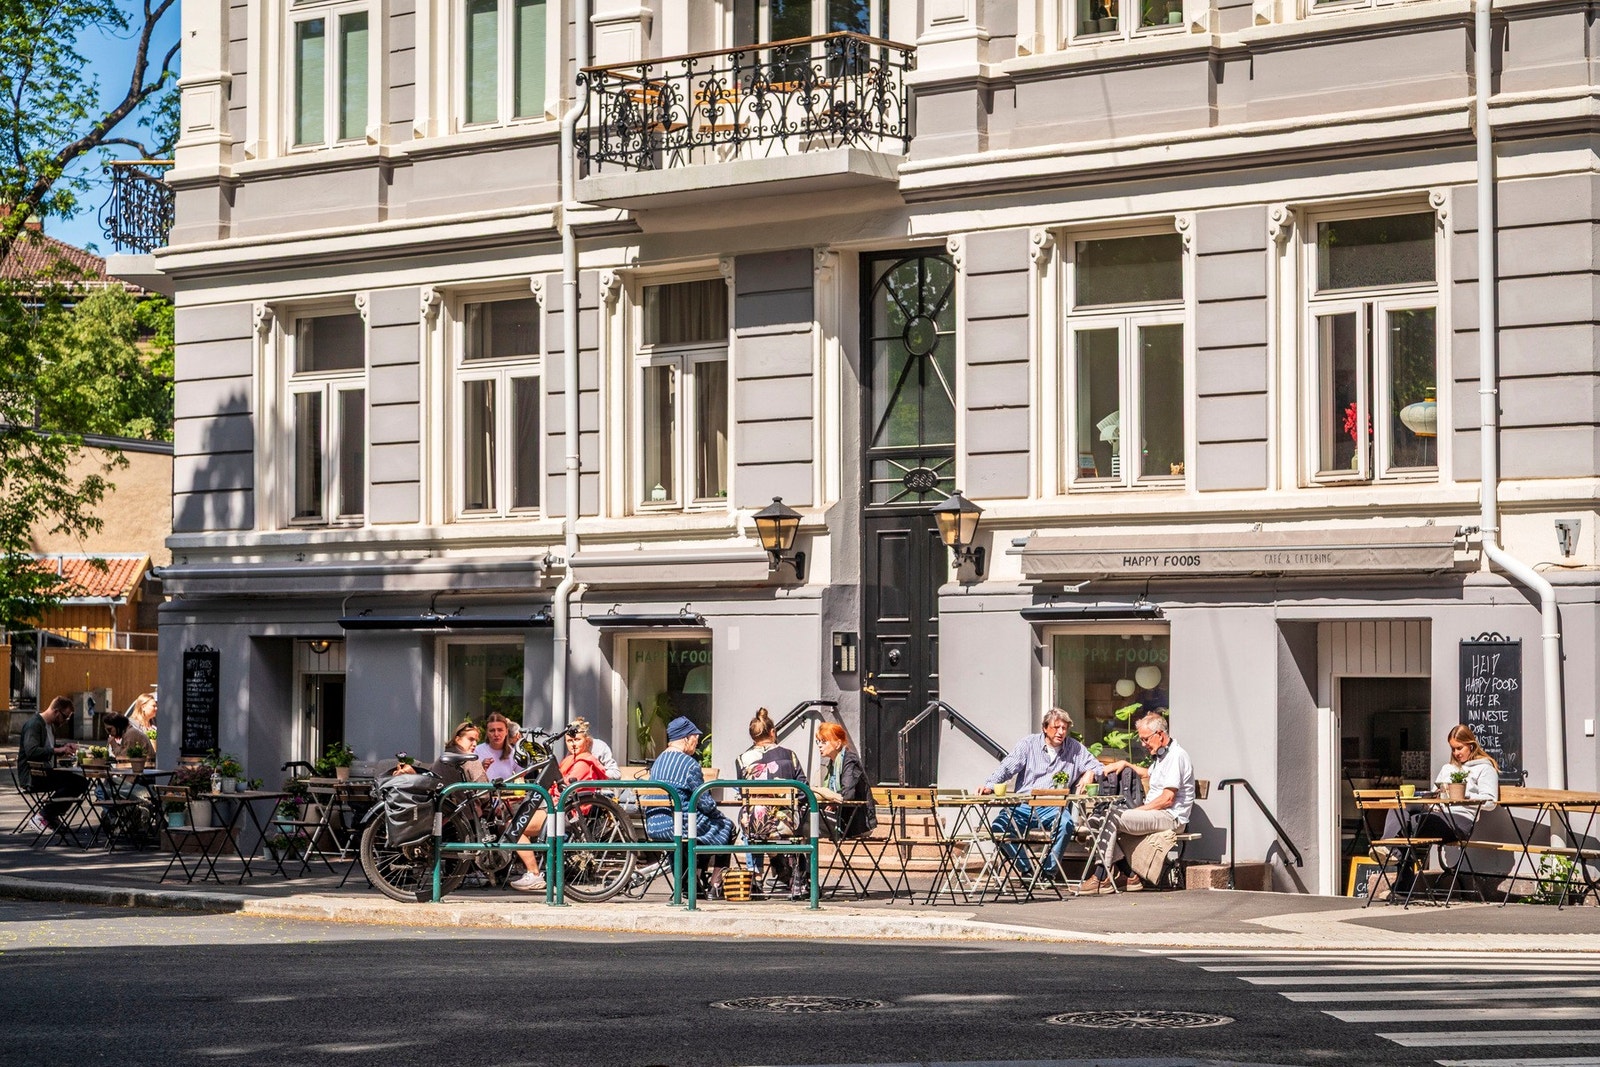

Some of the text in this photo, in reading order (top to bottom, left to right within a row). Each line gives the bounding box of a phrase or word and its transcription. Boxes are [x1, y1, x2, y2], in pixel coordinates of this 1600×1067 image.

[1122, 555, 1201, 567] HAPPY FOODS
[1264, 552, 1333, 565] CAFÉ & CATERING
[1116, 648, 1169, 663] FOODS
[1465, 676, 1518, 693] HAPPY FOODS
[1488, 693, 1501, 706] ER
[1481, 710, 1509, 722] NESTE
[1488, 724, 1503, 735] TIL
